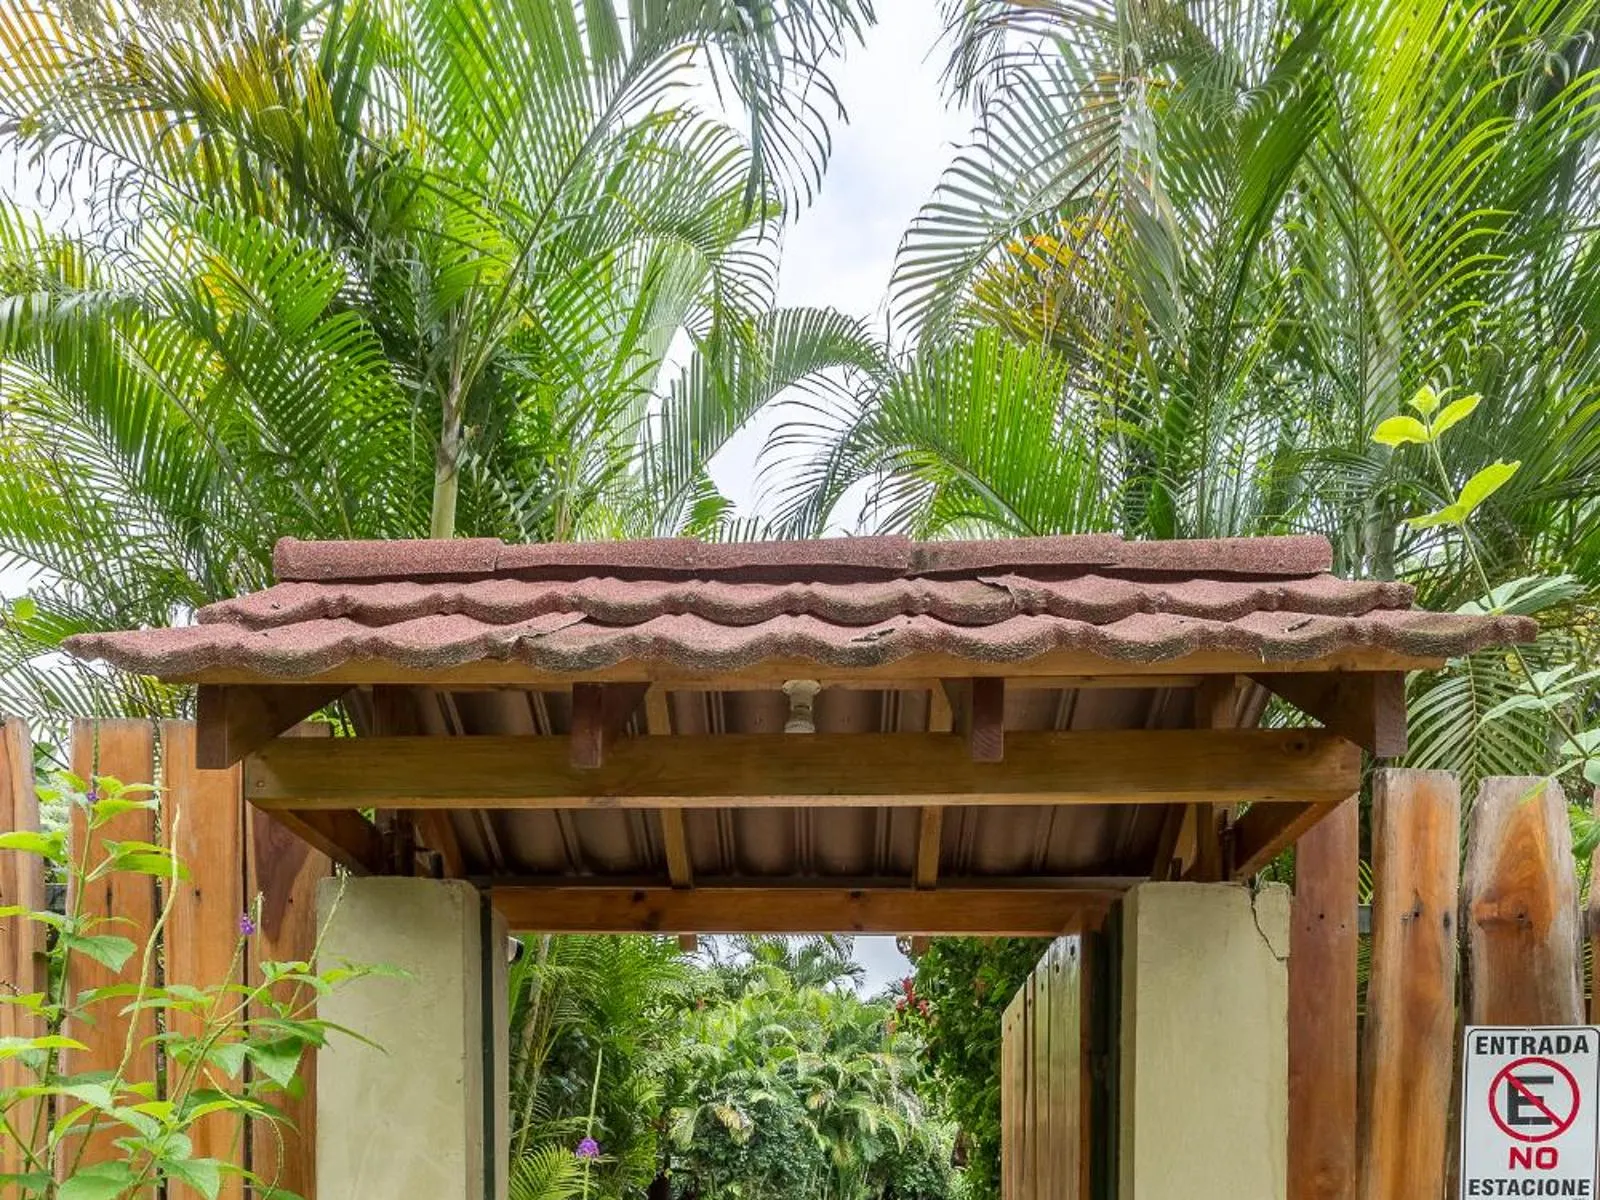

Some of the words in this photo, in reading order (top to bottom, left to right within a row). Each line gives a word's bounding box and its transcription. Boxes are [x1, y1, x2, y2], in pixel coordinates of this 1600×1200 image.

[1475, 1035, 1589, 1055] ENTRADA
[1507, 1075, 1554, 1125] E
[1508, 1146, 1559, 1170] NO
[1468, 1178, 1590, 1196] ESTACIONE
